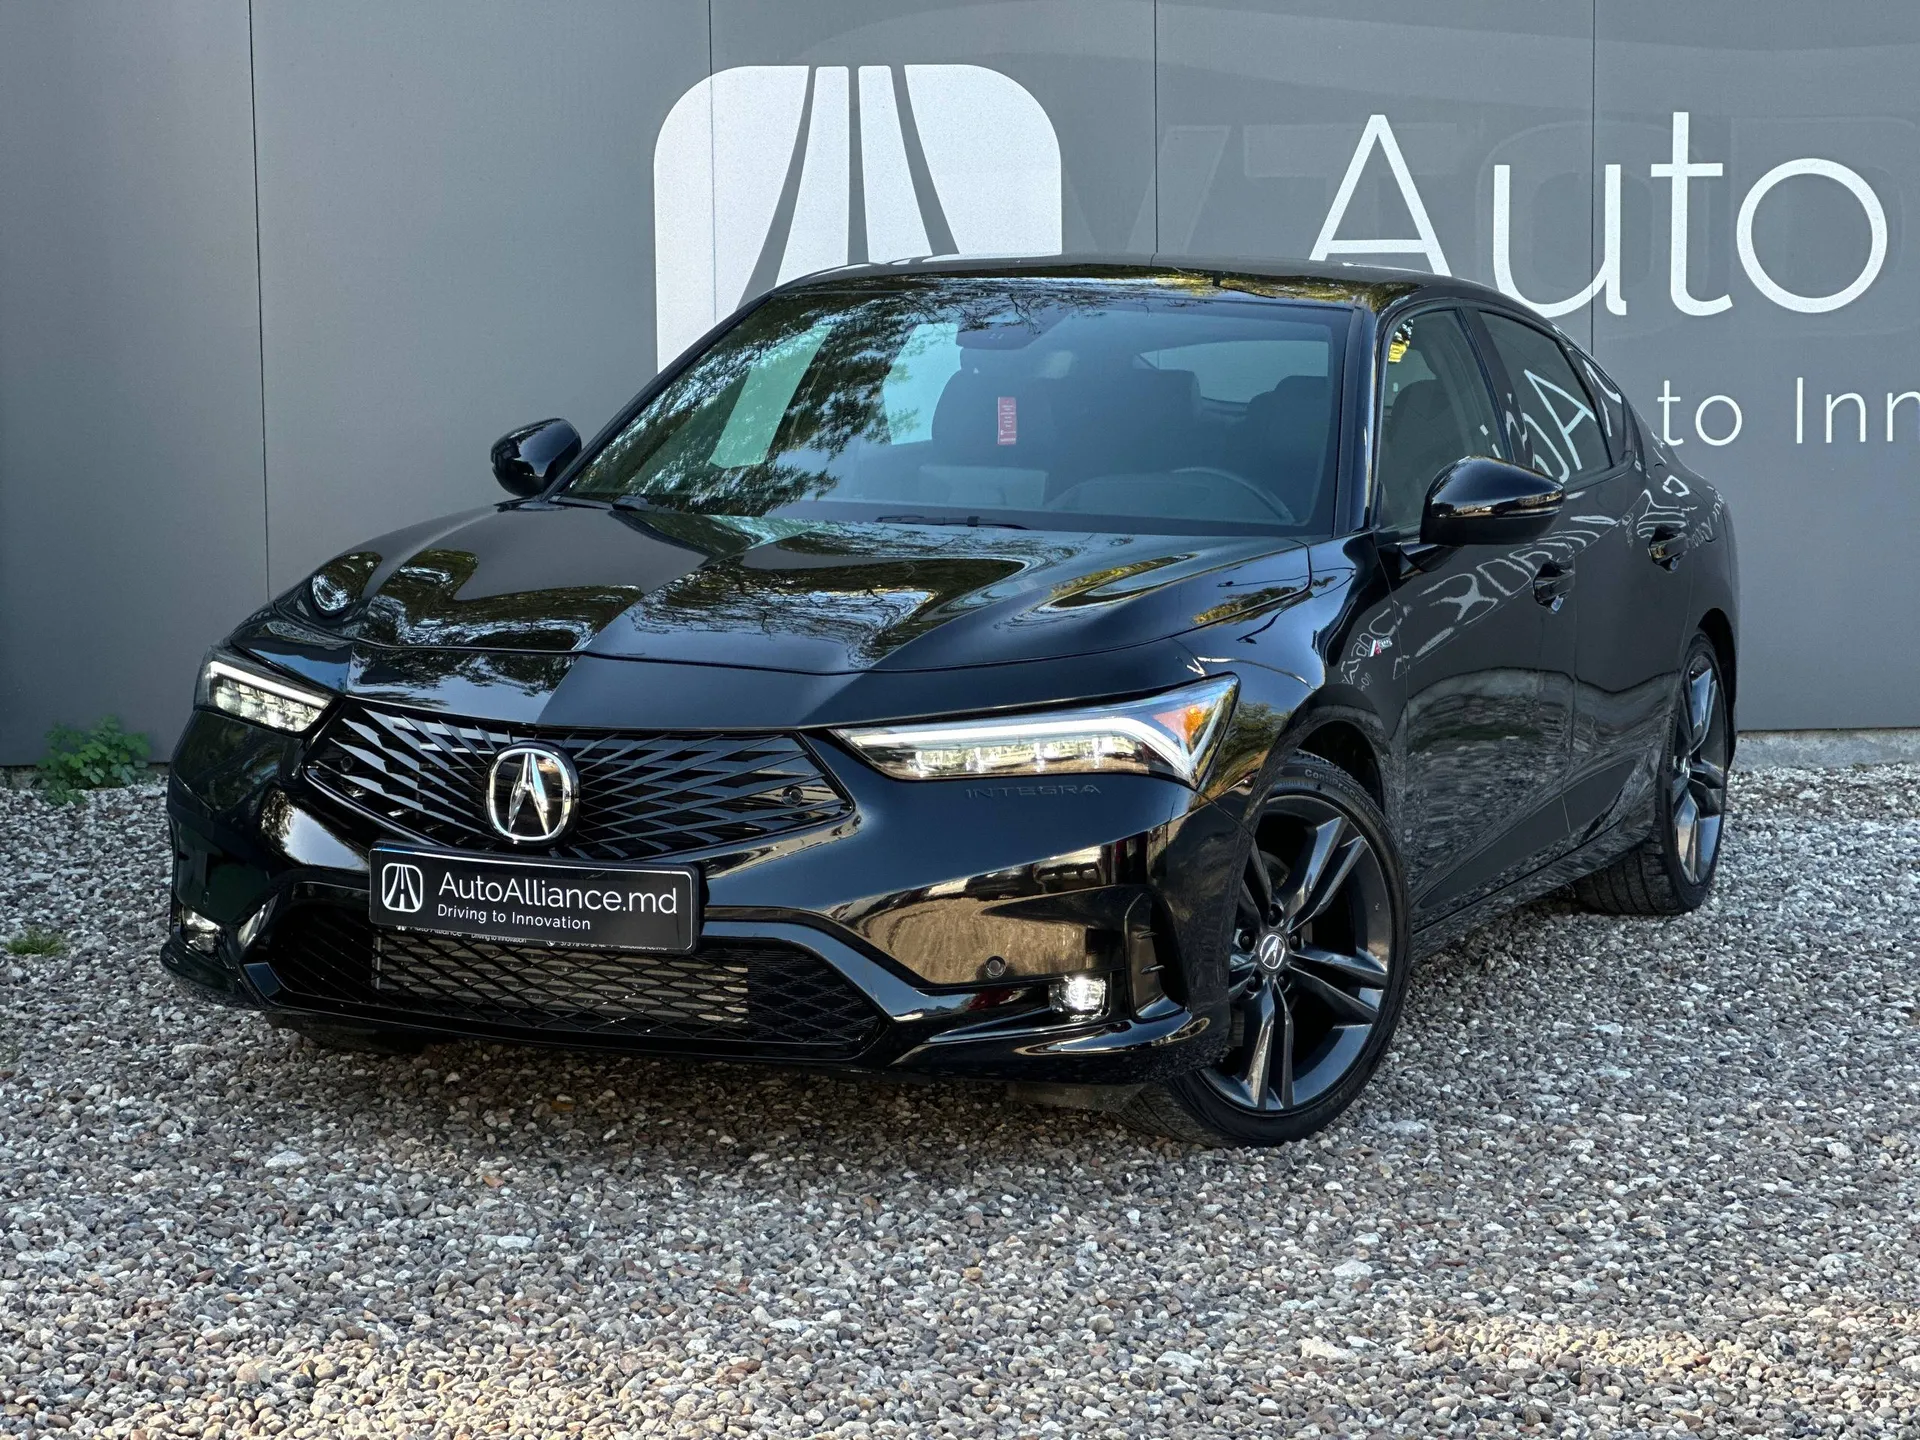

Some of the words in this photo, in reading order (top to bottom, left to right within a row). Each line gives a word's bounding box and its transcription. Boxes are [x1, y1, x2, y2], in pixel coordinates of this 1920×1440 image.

[1311, 112, 1888, 318] Auto
[1657, 380, 1743, 446] to
[965, 784, 1102, 799] INTEGRA
[438, 871, 677, 914] AutoAlliance.md
[437, 904, 487, 924] Driving
[492, 910, 507, 923] to
[512, 911, 591, 930] Innovation
